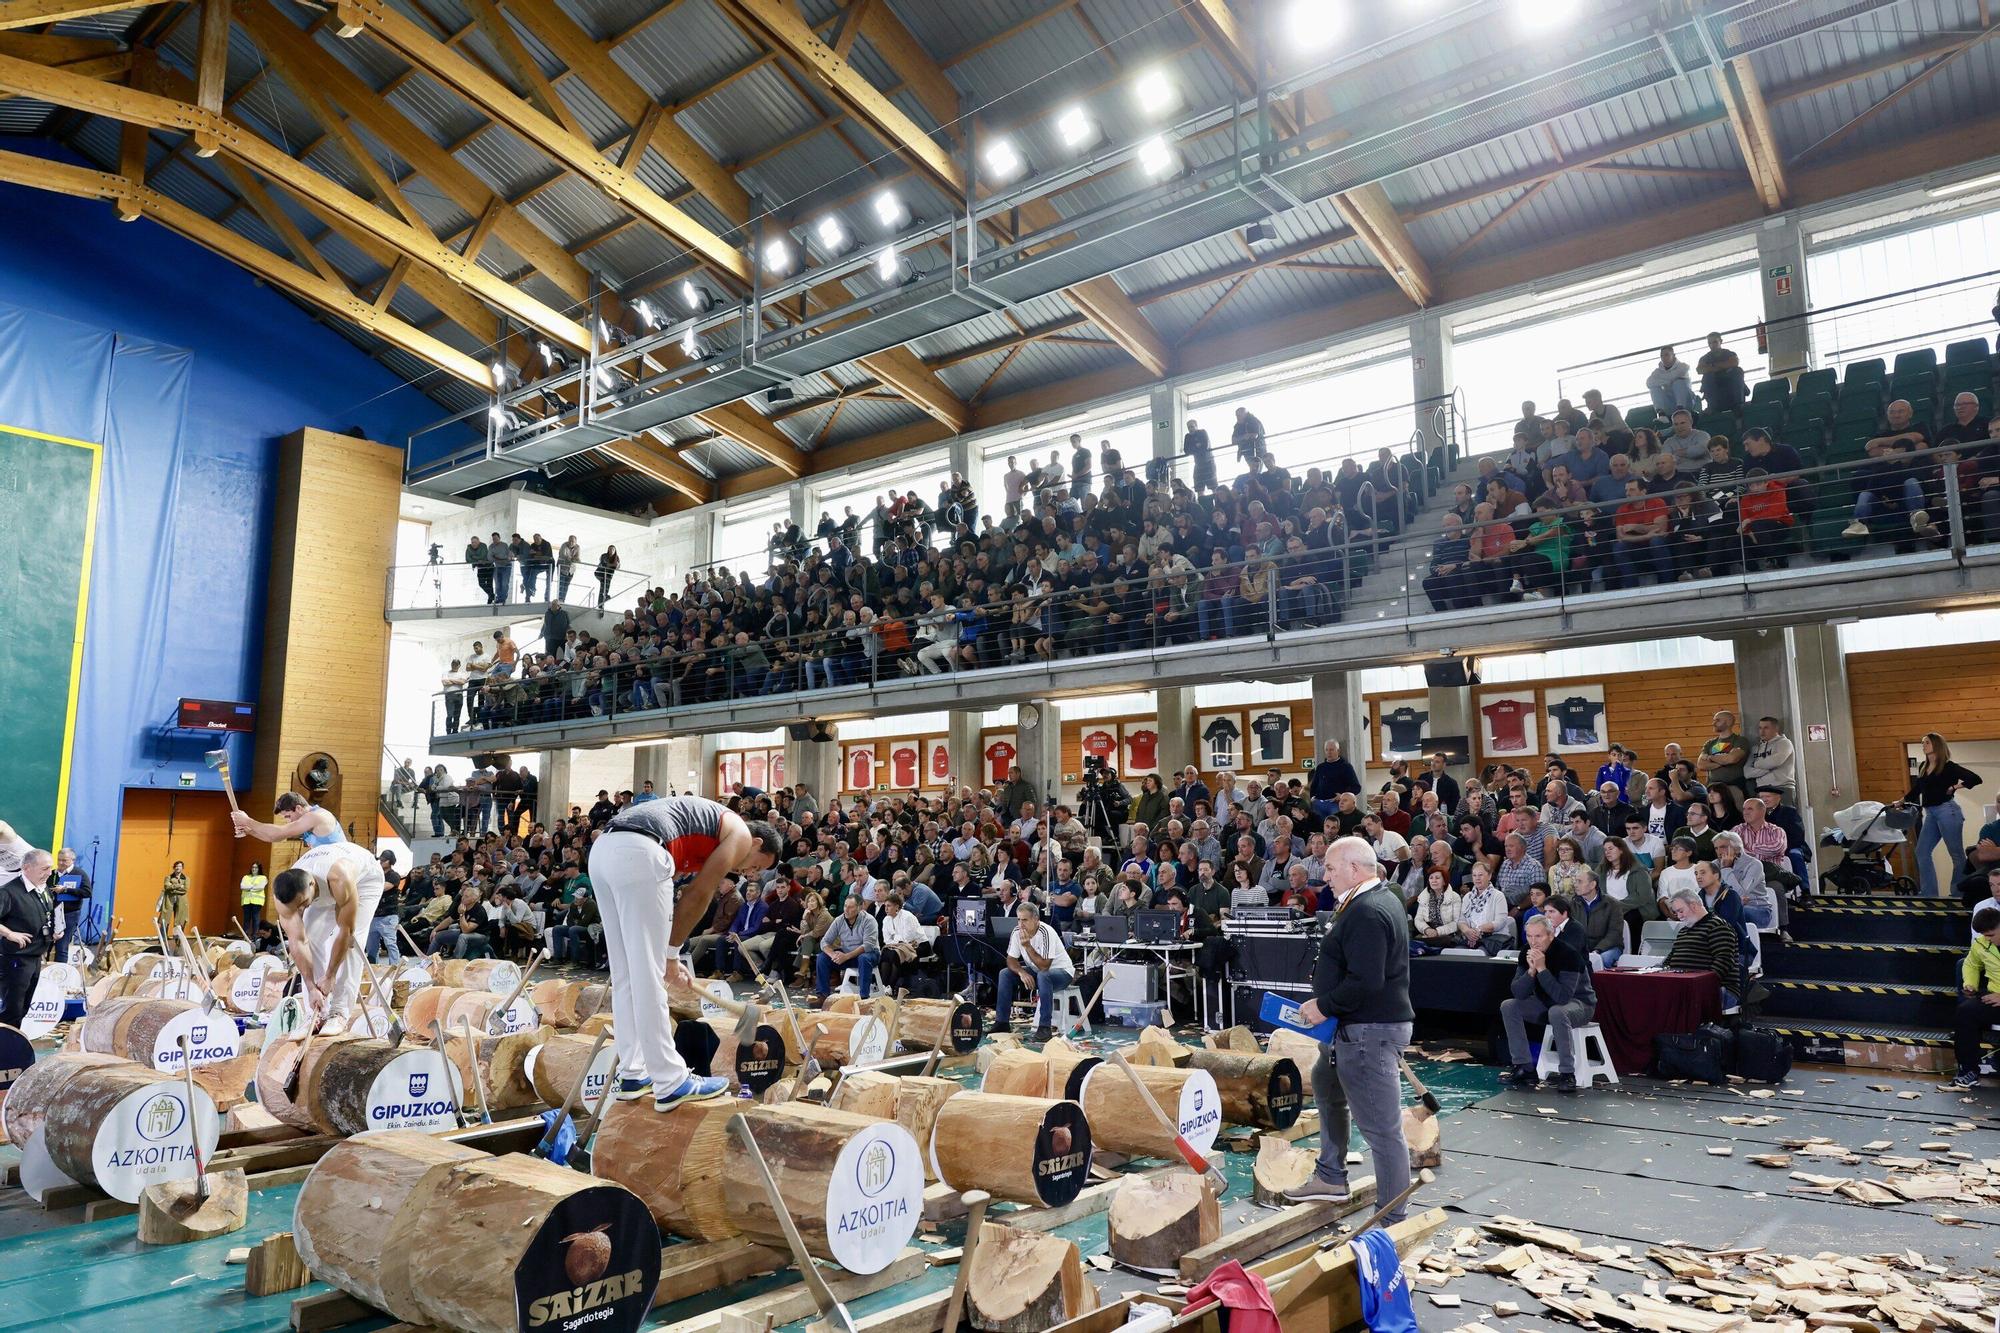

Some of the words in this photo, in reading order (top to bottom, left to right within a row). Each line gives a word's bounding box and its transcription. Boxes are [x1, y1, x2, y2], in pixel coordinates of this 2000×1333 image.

[234, 990, 259, 998] GIPUZ
[29, 1001, 58, 1012] KADI
[860, 1046, 882, 1056] KOITIA
[372, 1101, 454, 1120] GIPUZKOA
[1180, 1109, 1219, 1135] GIPUZKOA
[107, 1144, 196, 1168] AZKOITIA
[135, 1164, 167, 1175] Udala
[837, 1196, 908, 1234] AZKOITIA
[860, 1226, 886, 1240] Udala
[562, 1306, 614, 1331] Sagardotegia
